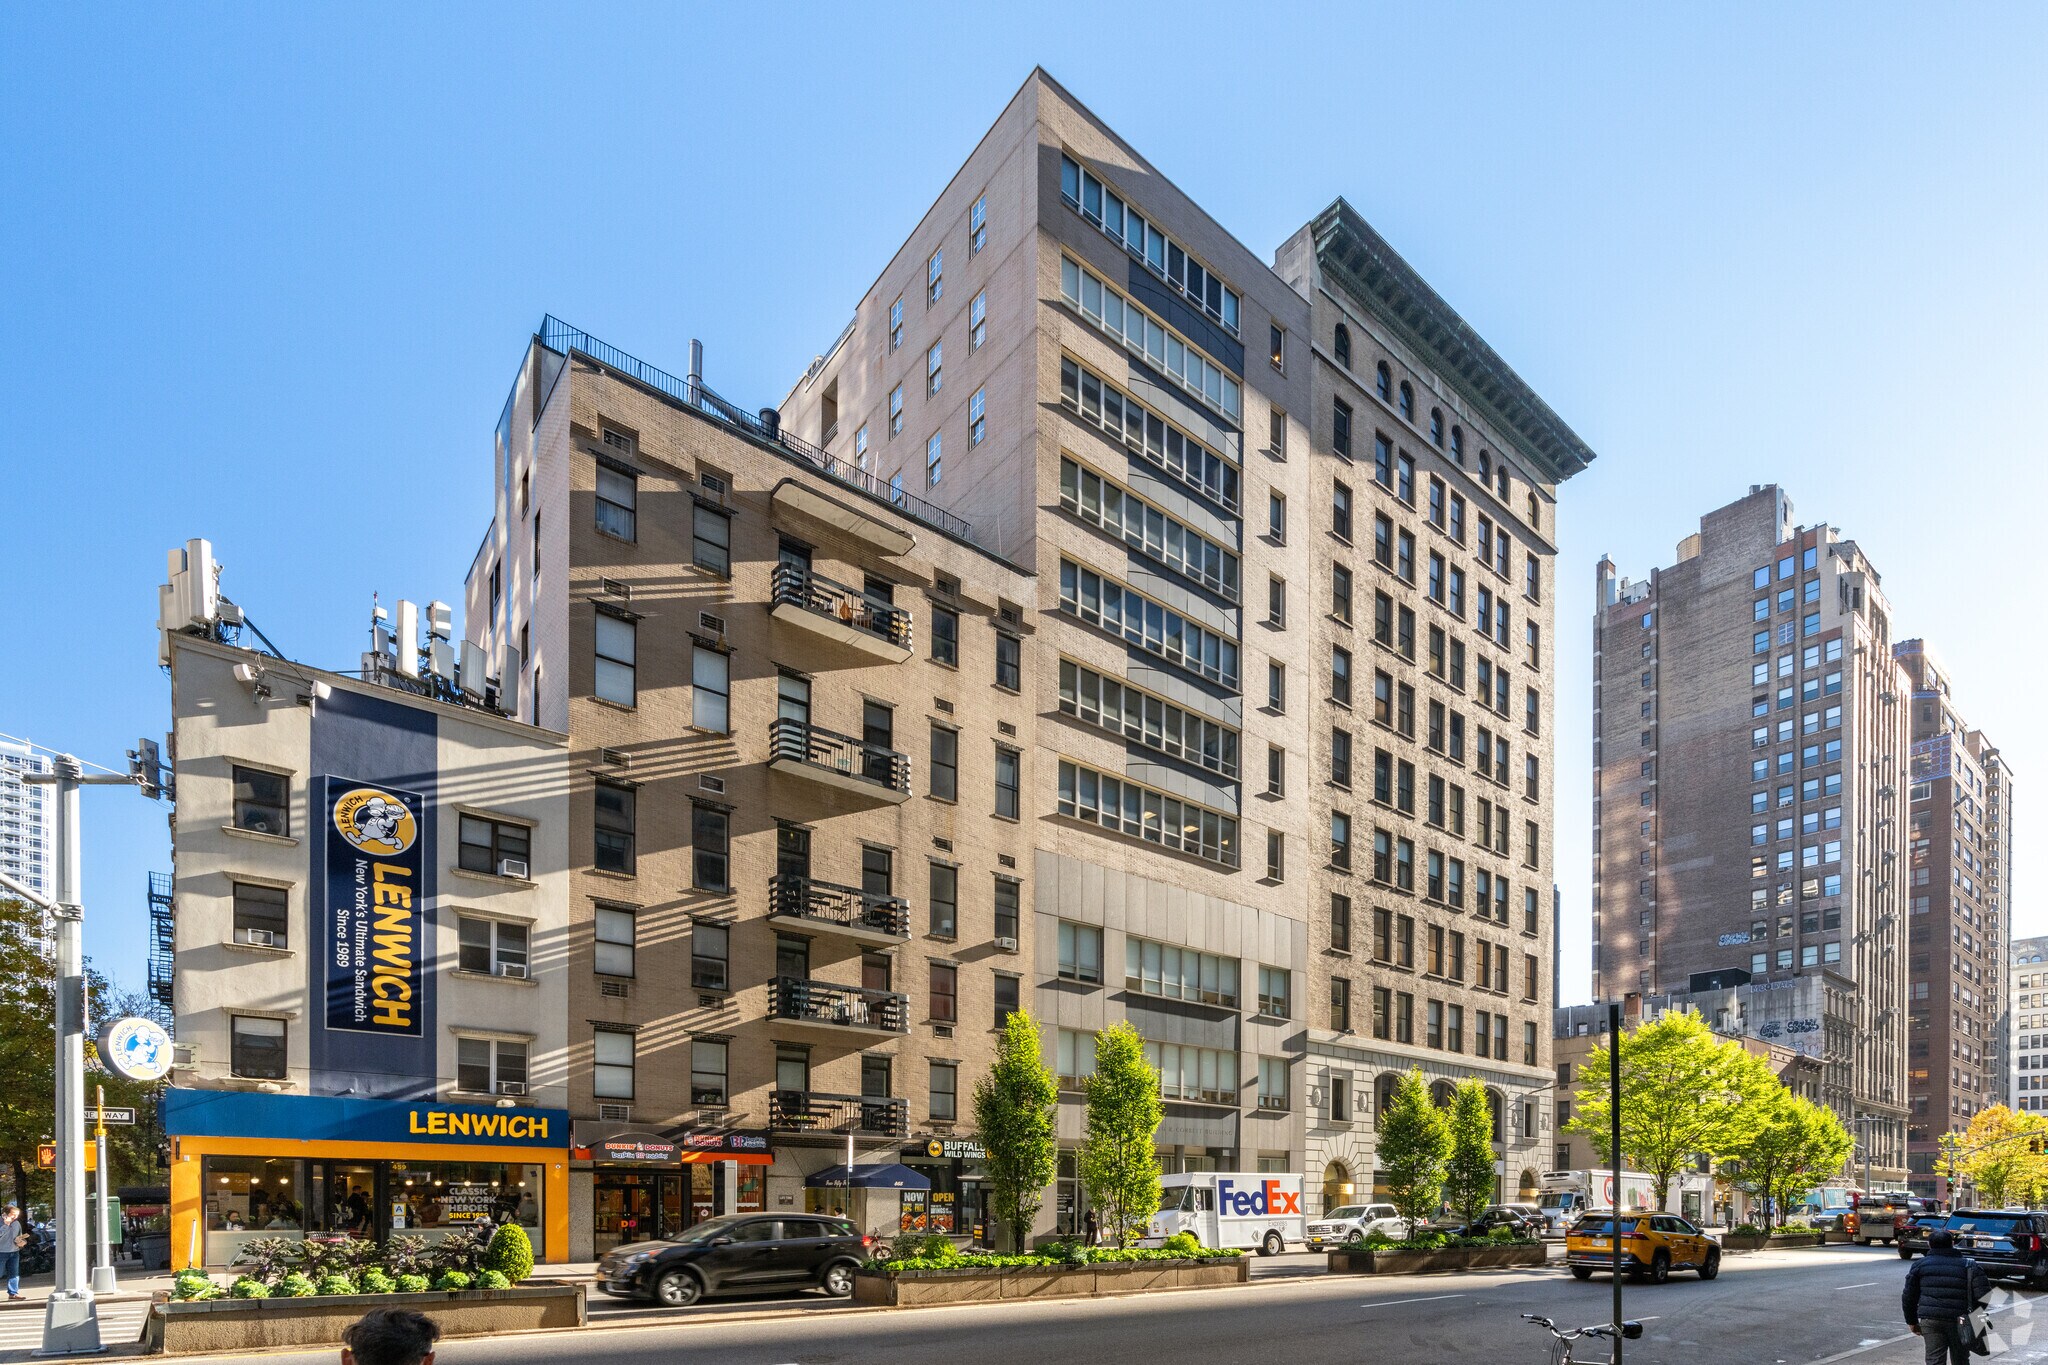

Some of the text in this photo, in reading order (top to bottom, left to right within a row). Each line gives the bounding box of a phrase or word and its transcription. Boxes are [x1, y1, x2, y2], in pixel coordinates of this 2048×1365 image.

[340, 795, 363, 829] LENWICH
[336, 908, 350, 968] Since 1989
[354, 858, 368, 1022] New York's Ultimate Sandwich
[371, 862, 412, 1027] LENWICH
[115, 1025, 132, 1056] LENWICH
[84, 1111, 95, 1119] NE
[409, 1111, 548, 1138] LENWICH
[1206, 1128, 1233, 1136] BUILDING
[963, 1151, 986, 1159] WINGS
[449, 1187, 488, 1196] CLASSIC
[440, 1195, 497, 1204] NEW YORK
[904, 1192, 955, 1203] NOW OPEN
[1218, 1180, 1300, 1216] FedEx
[395, 1205, 403, 1213] A
[449, 1204, 489, 1212] HEROES
[1267, 1219, 1288, 1227] Express
